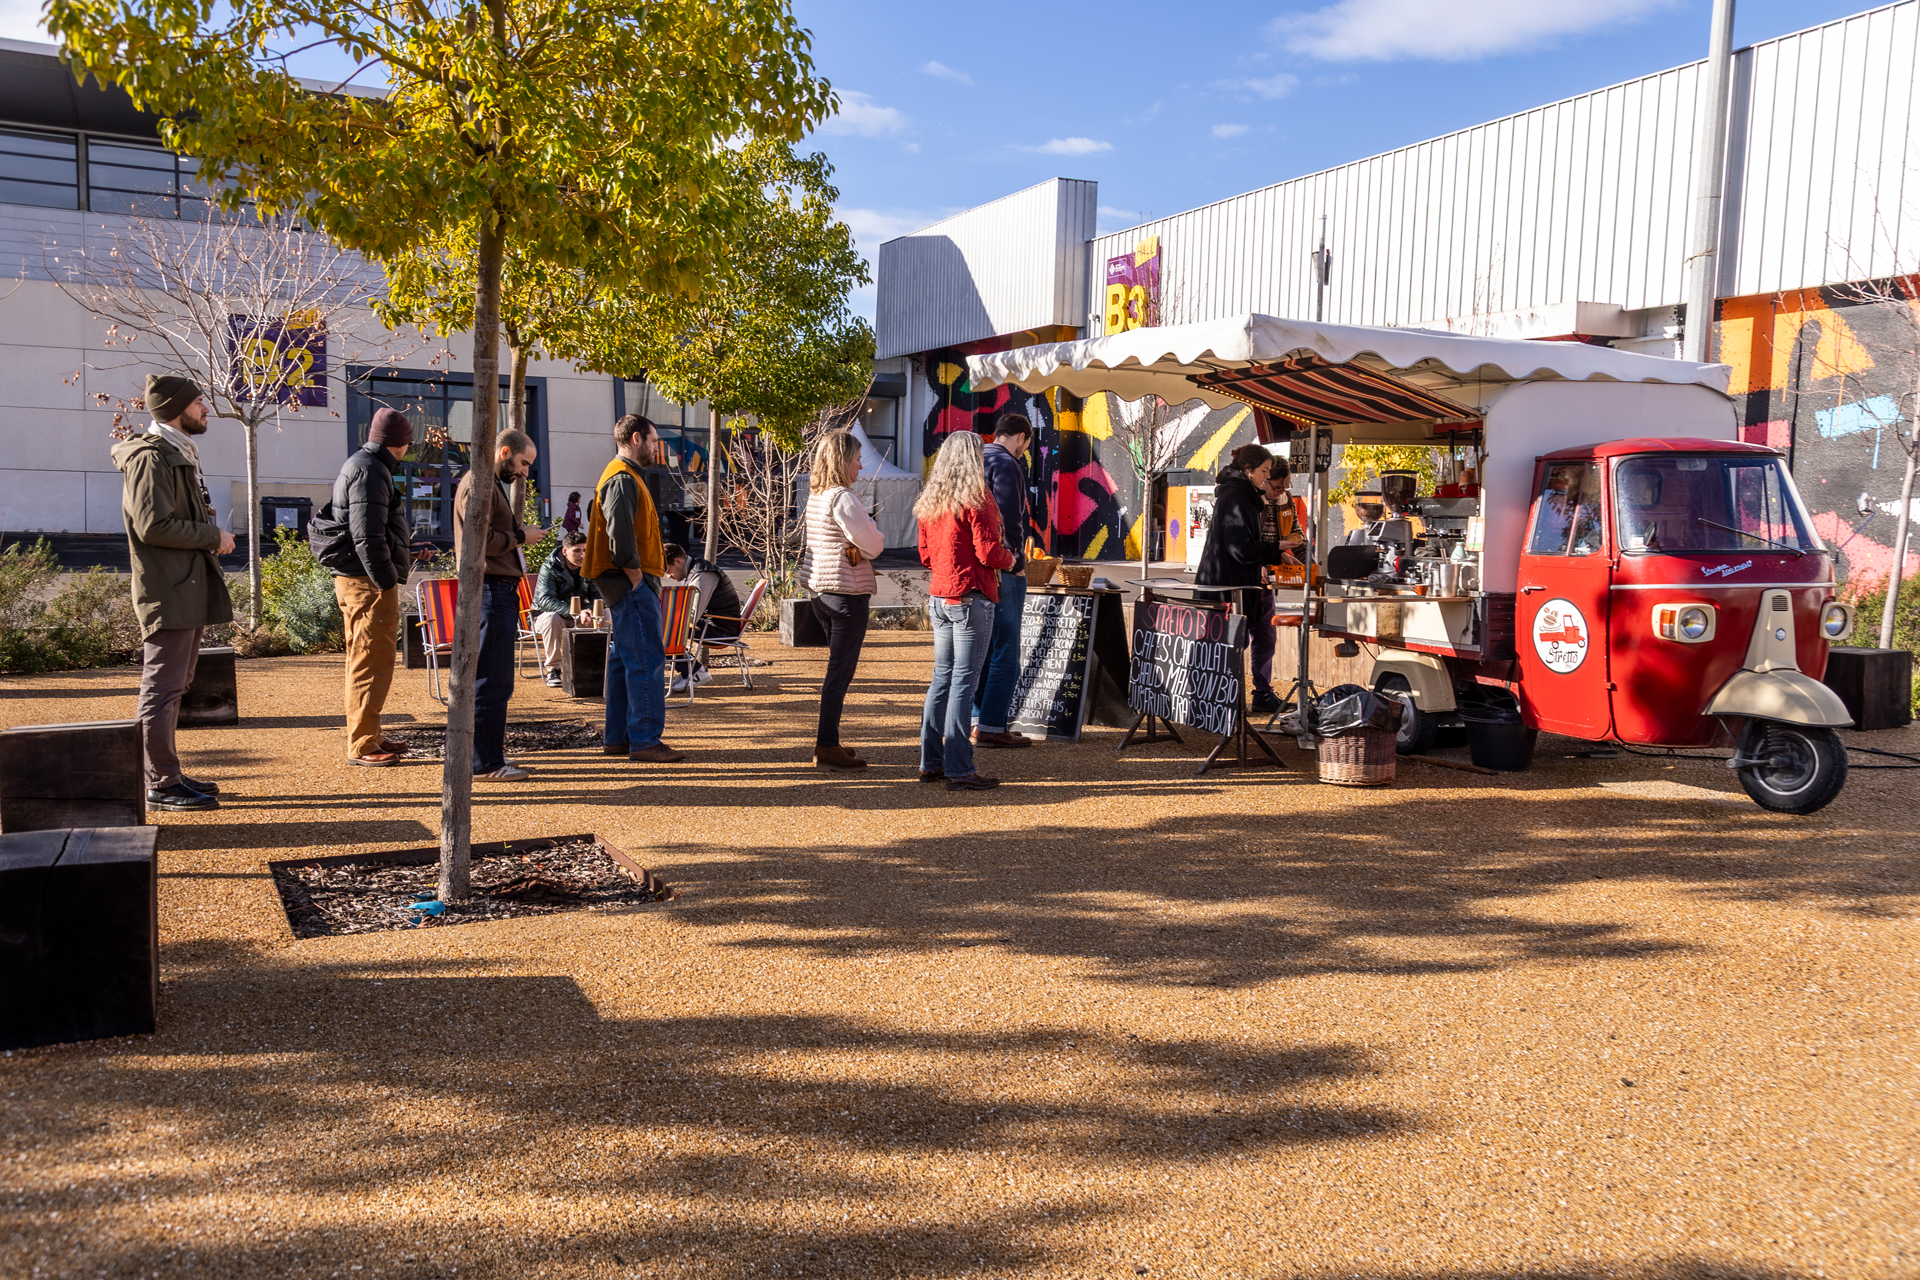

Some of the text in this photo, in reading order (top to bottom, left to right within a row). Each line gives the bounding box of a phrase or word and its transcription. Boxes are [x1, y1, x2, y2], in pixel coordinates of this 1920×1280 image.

[1105, 283, 1147, 336] B3
[243, 338, 314, 386] B2
[1023, 595, 1046, 615] etto
[1142, 604, 1223, 642] STRETTO BIO
[1030, 657, 1069, 670] MOMENT
[1173, 636, 1234, 674] CHOCOLAT
[1545, 648, 1579, 664] Stretto
[1130, 656, 1164, 688] CHAUD
[1164, 662, 1218, 700] MAISON
